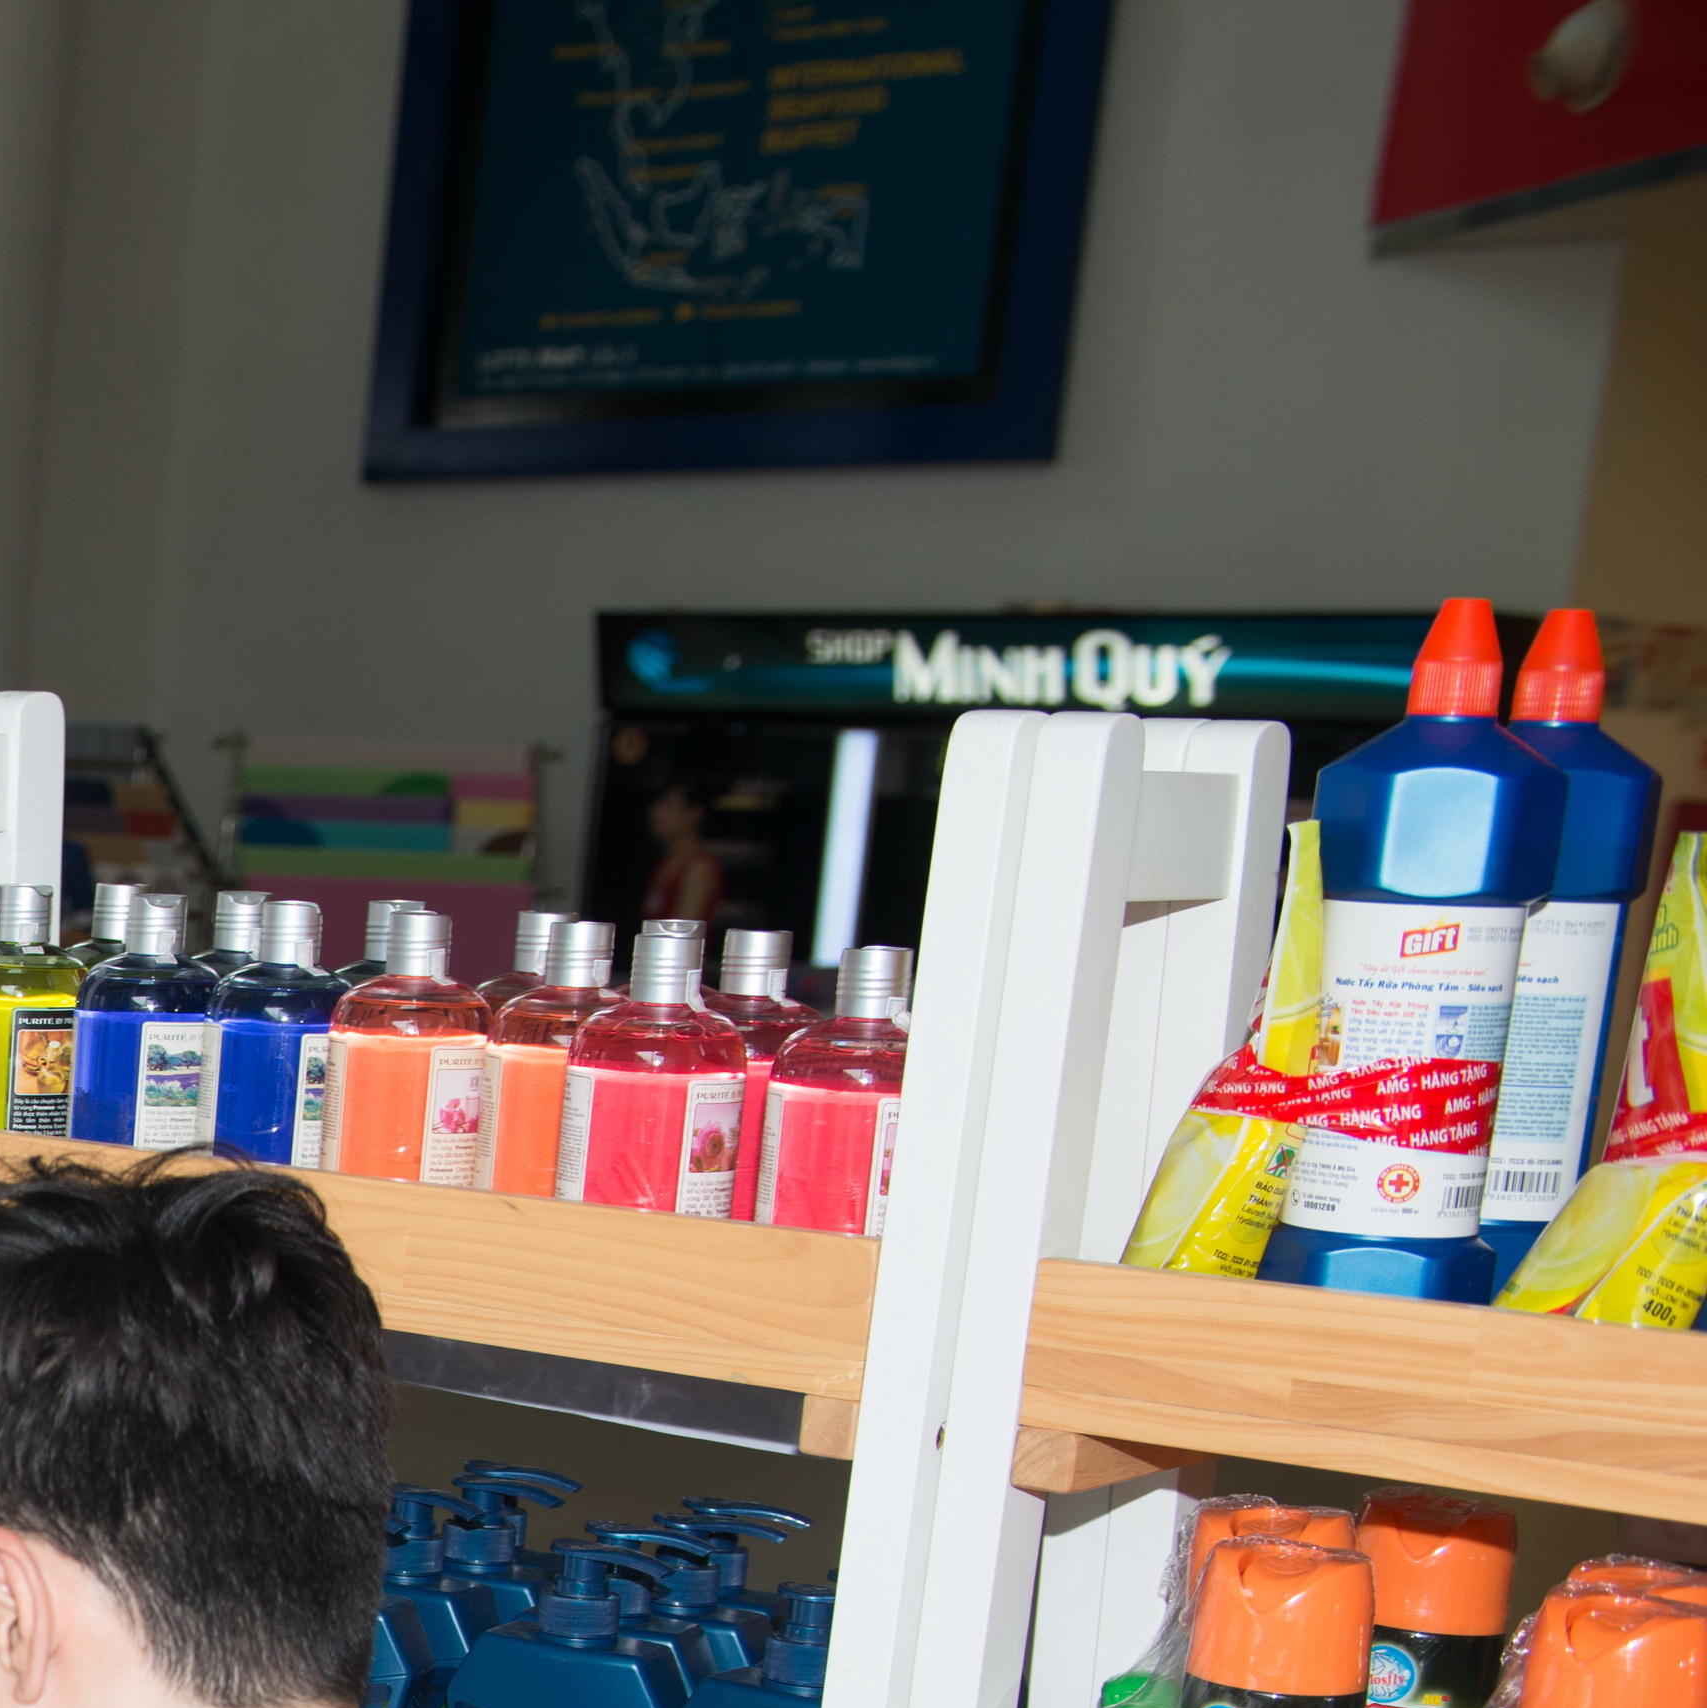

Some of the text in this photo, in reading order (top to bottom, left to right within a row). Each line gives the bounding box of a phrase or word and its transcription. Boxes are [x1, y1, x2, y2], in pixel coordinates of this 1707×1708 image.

[805, 629, 887, 663] SHOP
[892, 629, 1065, 704] MINH
[1335, 976, 1355, 987] Nước
[1401, 981, 1434, 994] Phòng
[1307, 1074, 1340, 1091] AMG
[1376, 1063, 1487, 1096] AMG HÀNG TẶNG
[1340, 1106, 1381, 1126] HÀNG
[1383, 1104, 1422, 1124] TẶNG
[1444, 1097, 1471, 1115] AMG
[1410, 1121, 1477, 1148] HÀNG TẶNG
[1628, 1112, 1689, 1140] HÀNG TẶNG
[1304, 1201, 1336, 1212] 18001289
